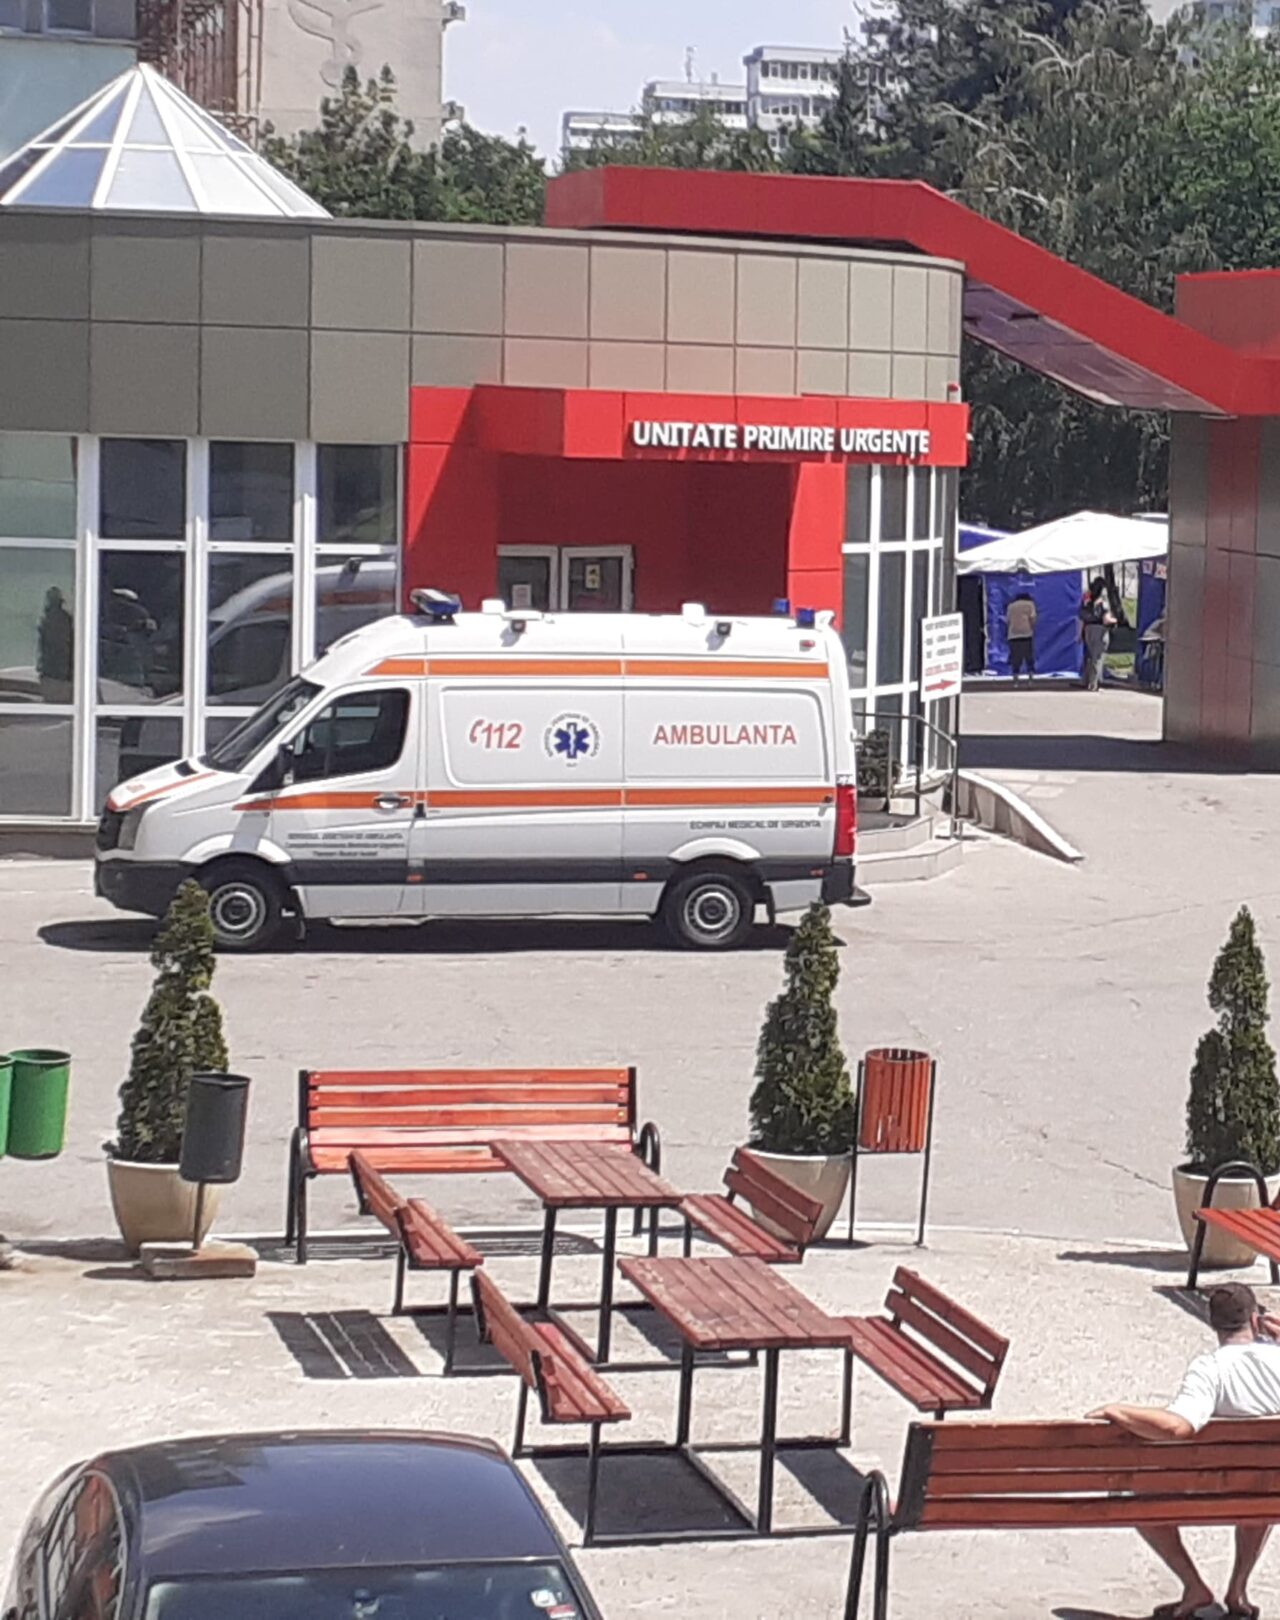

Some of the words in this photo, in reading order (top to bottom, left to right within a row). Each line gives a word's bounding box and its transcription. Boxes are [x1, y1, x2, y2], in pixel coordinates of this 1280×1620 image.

[633, 421, 737, 448] UNITATE
[743, 425, 834, 450] PRIMIRE
[481, 723, 523, 749] 112
[652, 724, 798, 745] AMBULANTA
